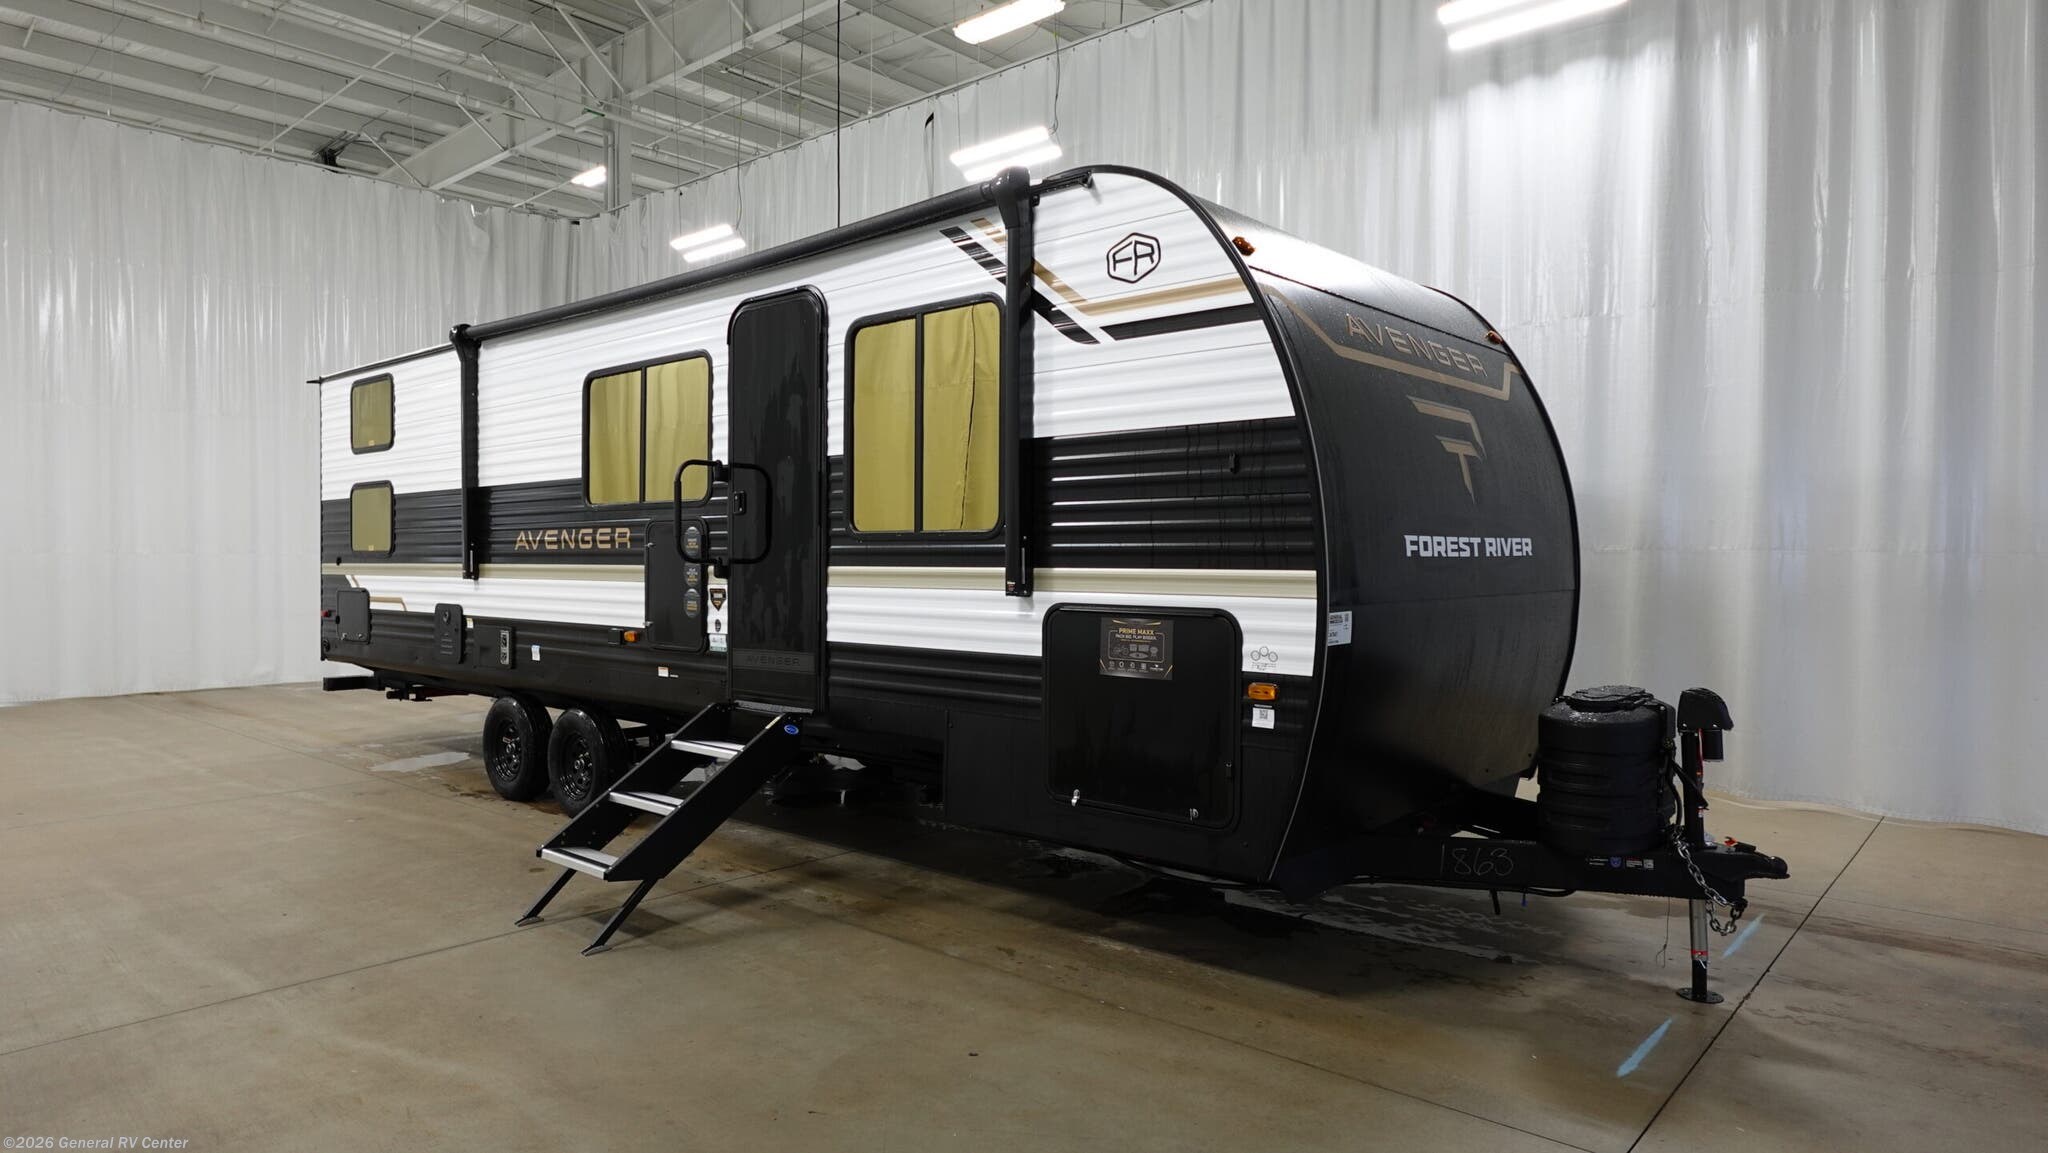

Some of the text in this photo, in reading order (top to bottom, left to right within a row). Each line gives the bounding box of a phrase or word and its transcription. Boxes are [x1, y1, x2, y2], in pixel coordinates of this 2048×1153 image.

[1345, 313, 1488, 377] AVENGER
[514, 527, 631, 551] AVENGER
[1404, 534, 1533, 557] FOREST RIVER
[1440, 843, 1514, 876] 1863
